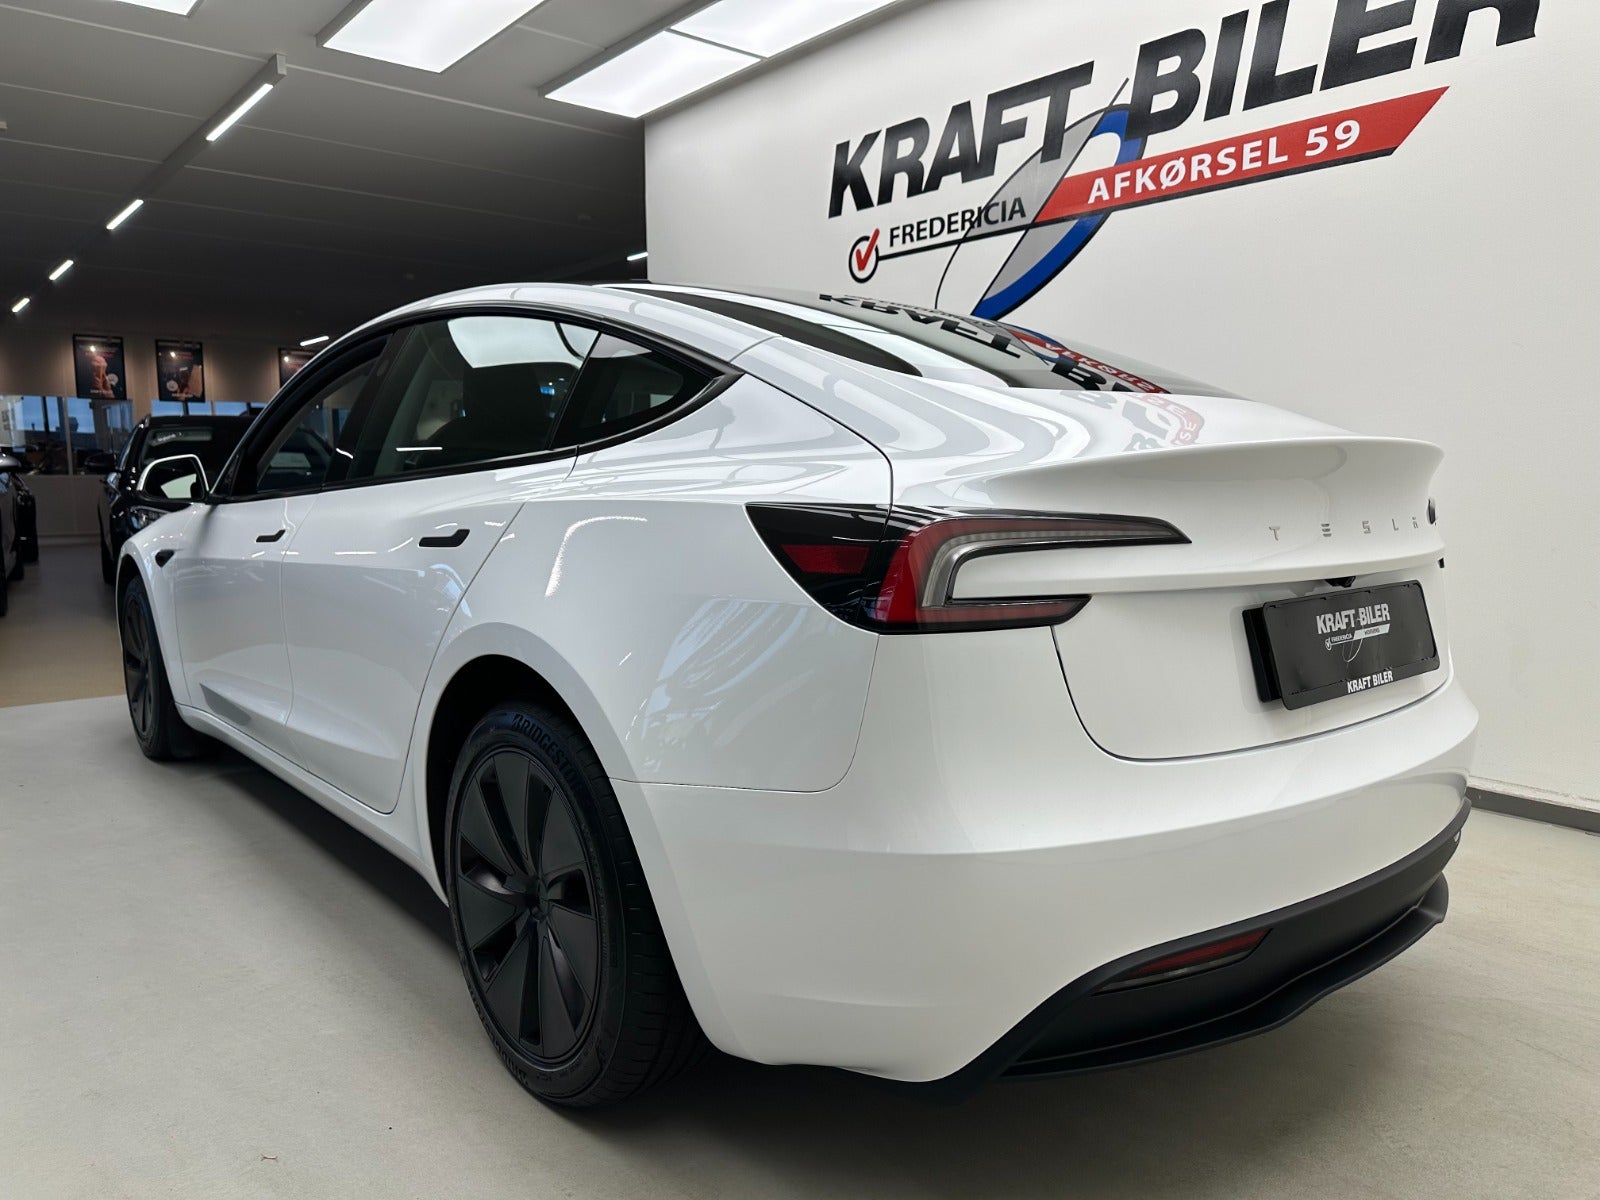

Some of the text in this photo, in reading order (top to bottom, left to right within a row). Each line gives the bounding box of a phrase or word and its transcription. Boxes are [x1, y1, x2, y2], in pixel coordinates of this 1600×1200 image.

[828, 61, 1094, 218] KRAFT
[1087, 120, 1361, 205] AFKØRSEL 59
[889, 197, 1026, 248] FREDERICIA
[1268, 517, 1419, 541] TESLA
[1316, 603, 1391, 635] KRAFT BILER
[1347, 670, 1394, 693] KRAFT BILER
